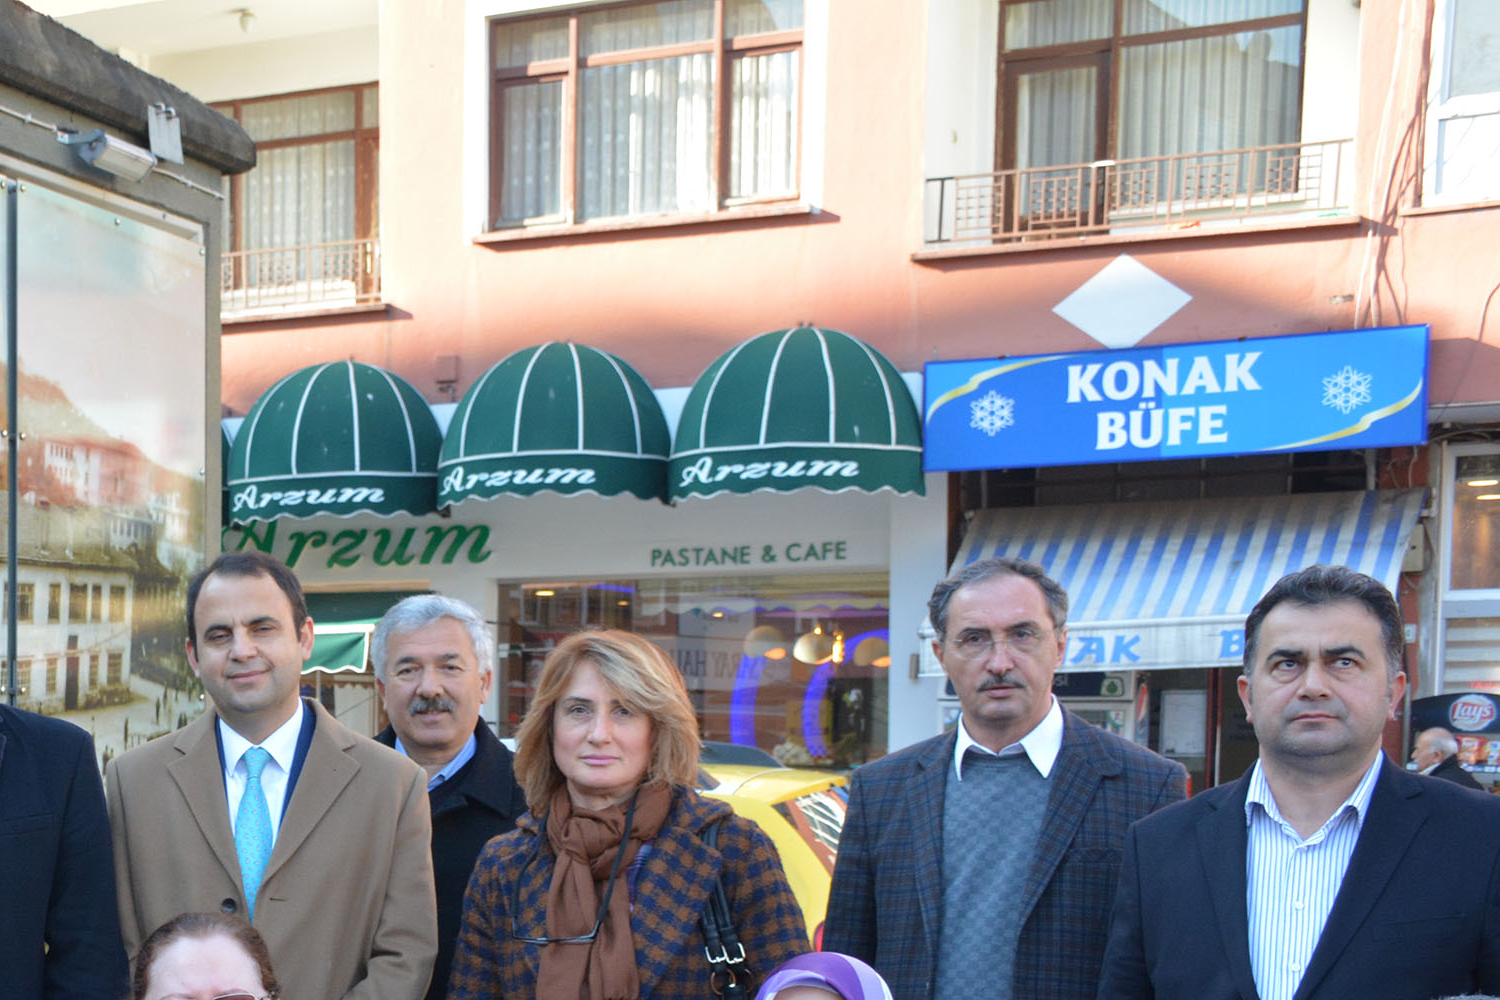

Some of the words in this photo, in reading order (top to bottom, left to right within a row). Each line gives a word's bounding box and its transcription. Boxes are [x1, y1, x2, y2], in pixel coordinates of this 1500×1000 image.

[1066, 352, 1263, 403] KONAK
[1095, 401, 1228, 450] BÜFE
[440, 466, 596, 495] Arzum
[679, 456, 860, 487] Arzum
[232, 484, 385, 512] Arzum
[651, 546, 750, 567] PASTANE
[761, 545, 777, 563] &
[786, 541, 847, 562] CAFE
